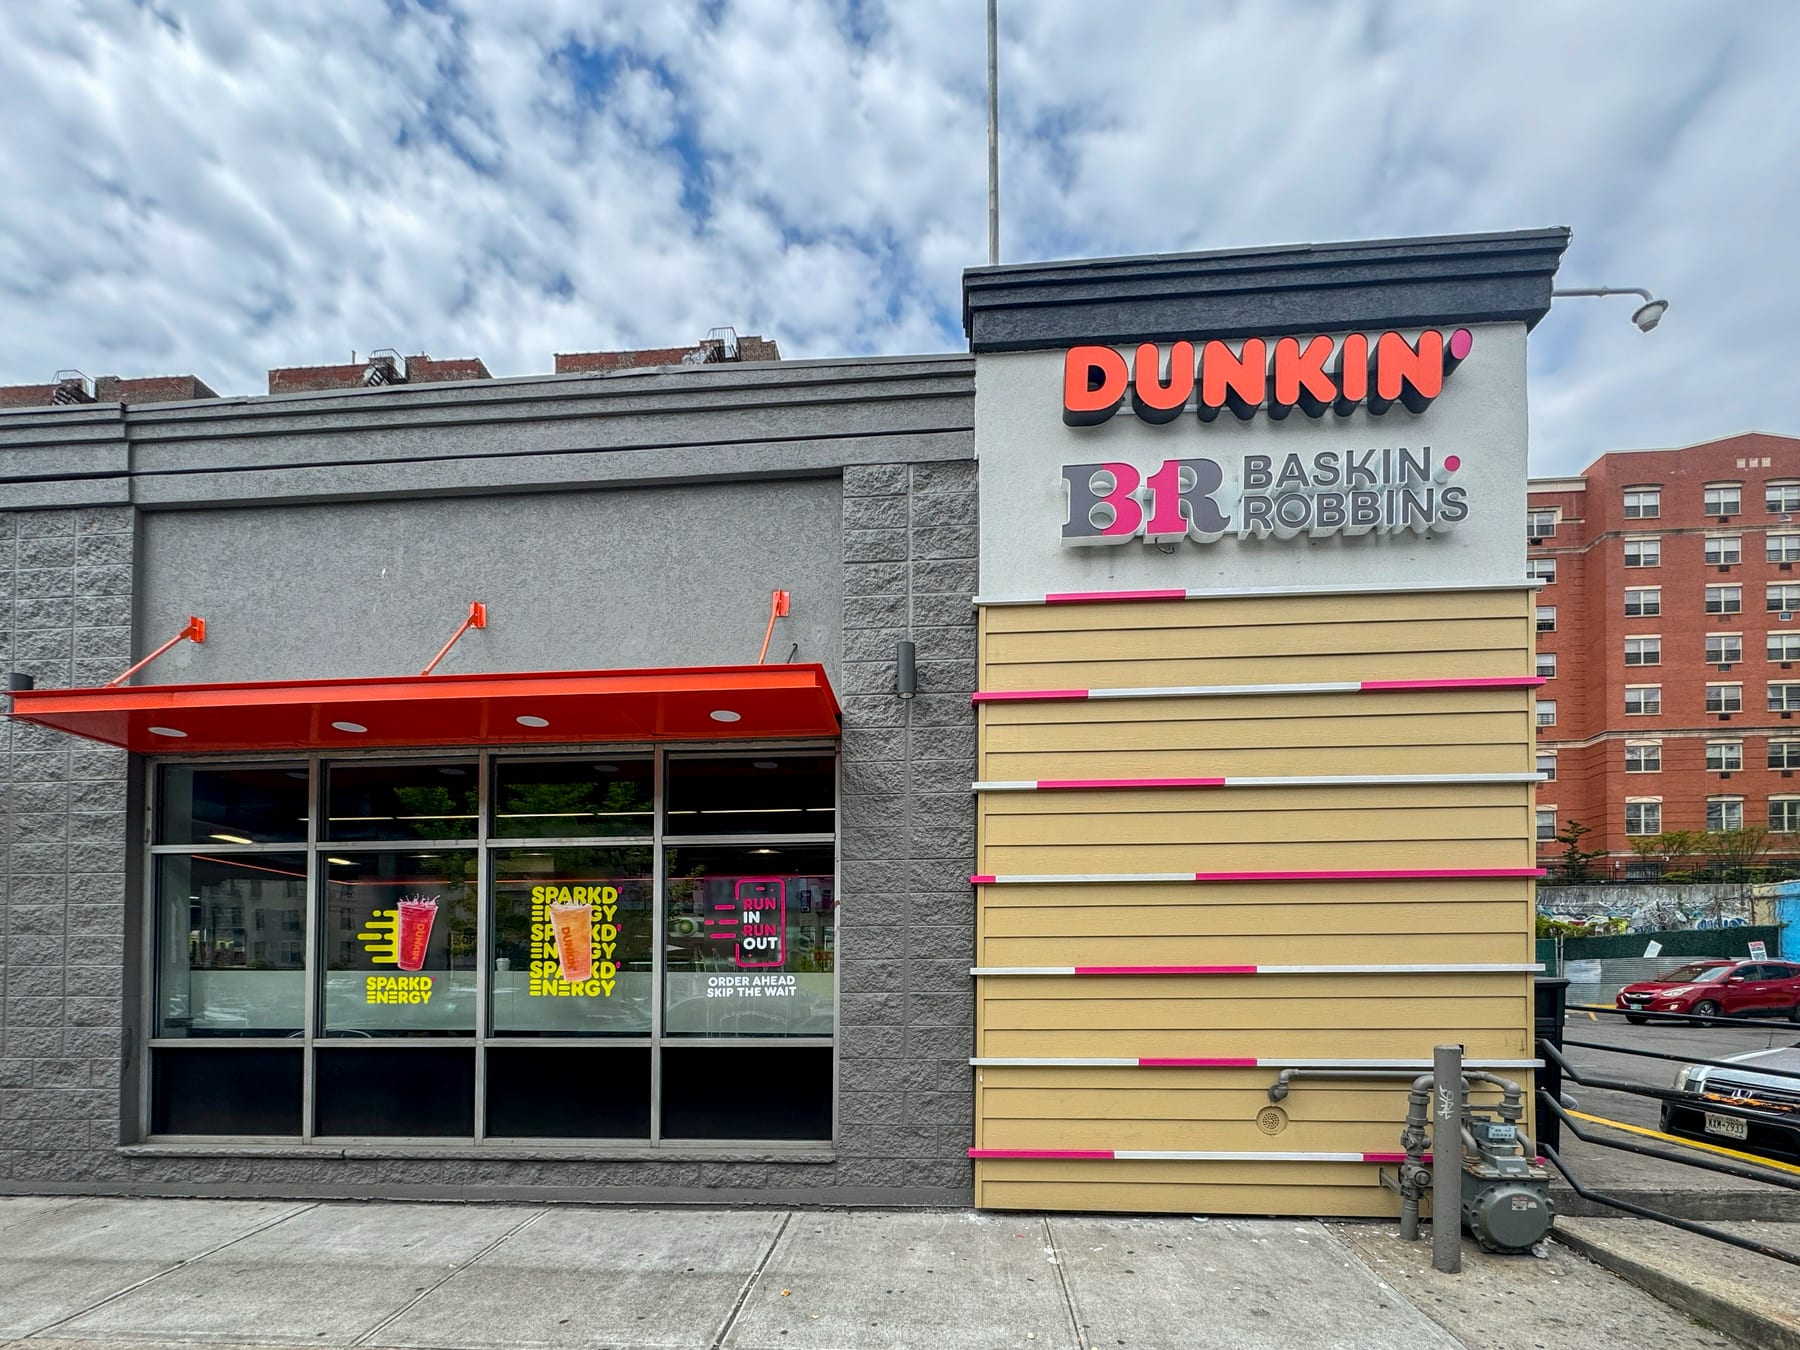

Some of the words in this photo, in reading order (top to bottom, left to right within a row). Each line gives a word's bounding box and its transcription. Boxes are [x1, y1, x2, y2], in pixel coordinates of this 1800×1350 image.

[1065, 328, 1473, 412] DUNKIN'
[1243, 447, 1431, 489] BASKIN
[1243, 487, 1469, 530] ROBBINS
[743, 897, 776, 910] RUN
[743, 911, 760, 923] IN
[530, 923, 622, 941] SPKD'
[743, 924, 777, 936] RUN
[530, 942, 617, 959] ENGY
[743, 937, 778, 950] OUT
[708, 977, 750, 986] ORDER
[752, 975, 796, 986] AHEAD
[529, 980, 616, 997] ENERGY
[706, 988, 734, 998] SKIP
[737, 987, 762, 997] THE
[764, 986, 797, 997] WAIT
[366, 990, 432, 1004] ENERGY
